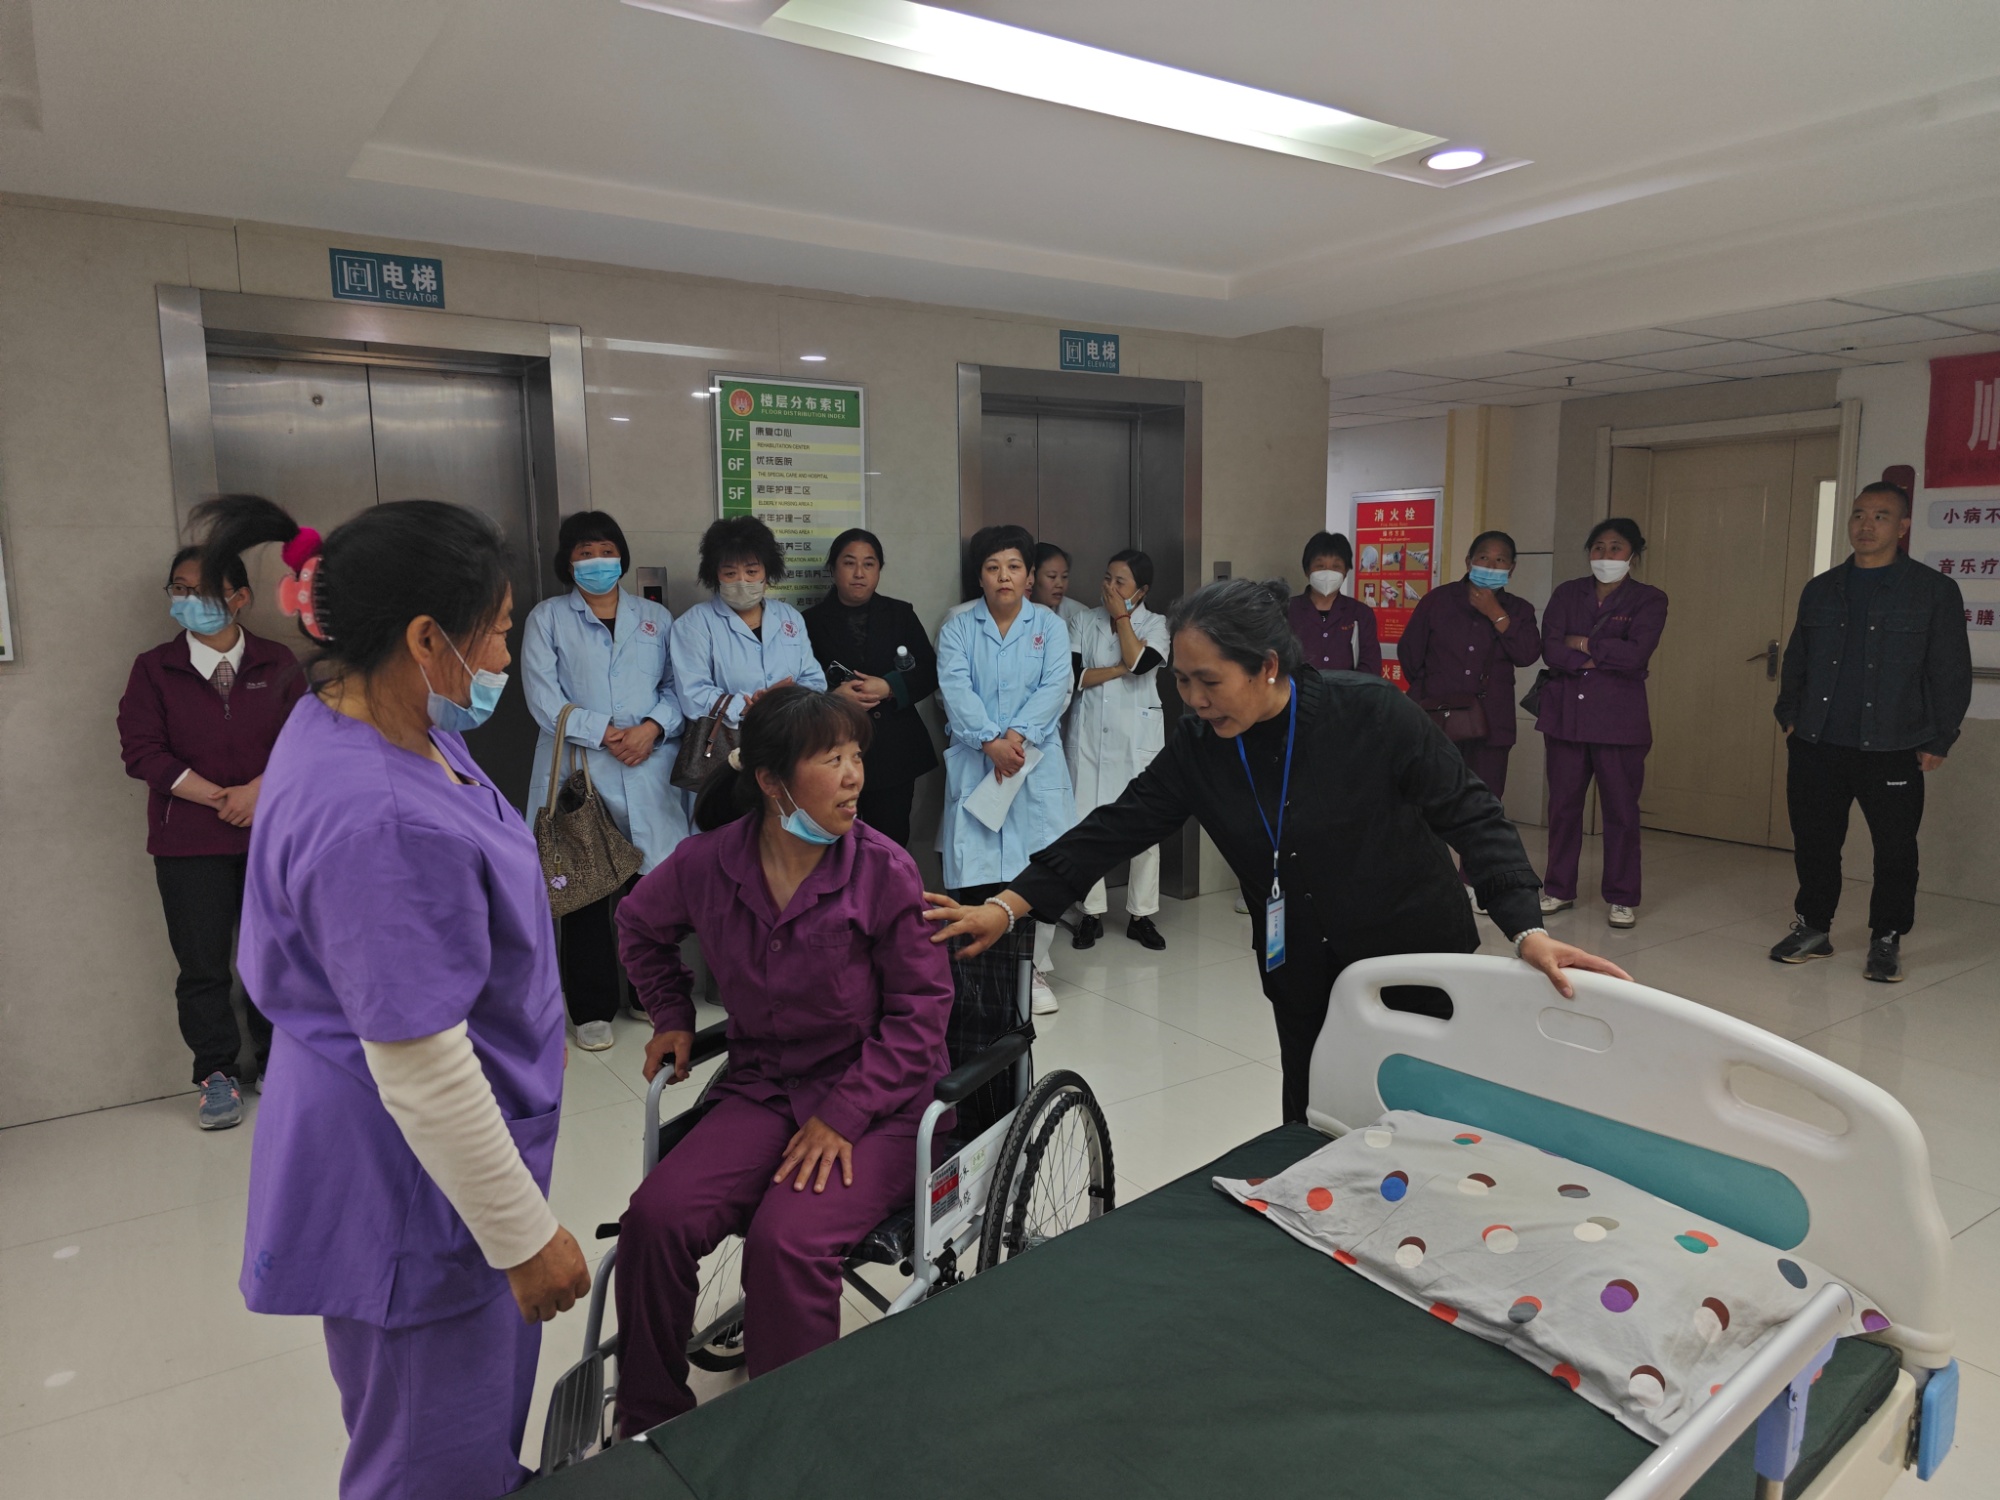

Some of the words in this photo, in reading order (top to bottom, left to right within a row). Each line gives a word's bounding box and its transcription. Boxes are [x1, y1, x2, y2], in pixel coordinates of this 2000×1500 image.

[382, 261, 437, 293] 电梯
[386, 290, 438, 303] ELEVATOR
[1087, 340, 1115, 361] 电梯
[1088, 360, 1116, 368] ELEVATOR
[760, 393, 846, 413] 楼层分布索引
[783, 410, 826, 418] DISTRIBUTION
[727, 428, 744, 442] 7F
[756, 427, 792, 438] 康复中心
[727, 458, 745, 471] 6F
[756, 456, 792, 466] 优抚医院
[728, 487, 745, 500] 5F
[757, 485, 811, 495] 老年护理二区
[1374, 507, 1415, 522] 消火栓
[1943, 507, 2000, 524] 小病不
[1938, 558, 2000, 575] 音乐疗
[787, 569, 834, 578] 老年休养二
